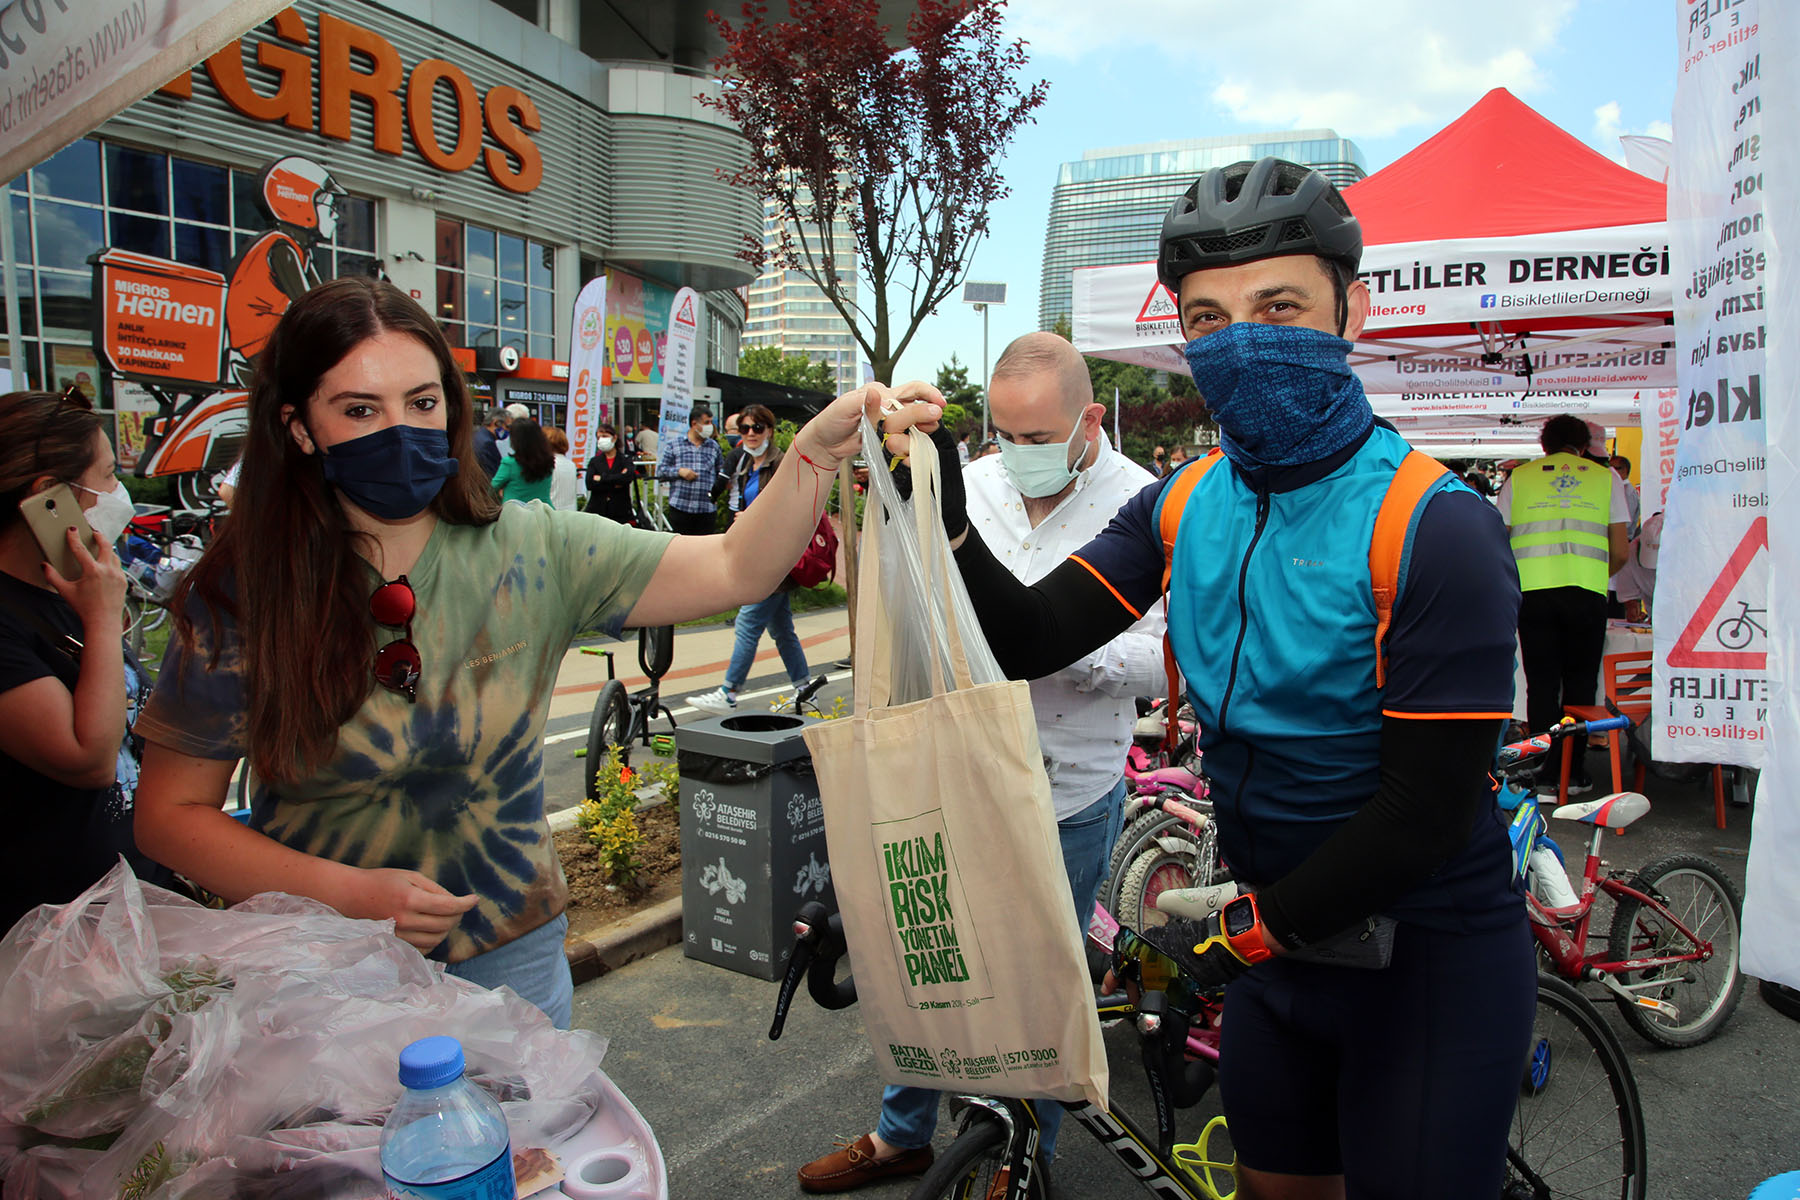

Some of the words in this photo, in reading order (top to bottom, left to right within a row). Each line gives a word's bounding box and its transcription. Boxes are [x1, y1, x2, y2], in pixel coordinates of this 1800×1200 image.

[158, 6, 543, 194] GROS
[1509, 245, 1670, 283] DERNEĞİ
[1501, 287, 1650, 308] BisikletlilerDerneği
[115, 293, 215, 327] Hemen
[117, 346, 131, 356] 30
[919, 1001, 930, 1010] 29
[888, 1043, 934, 1060] BATTAL
[1007, 1050, 1030, 1065] 570
[1030, 1047, 1058, 1062] 5000
